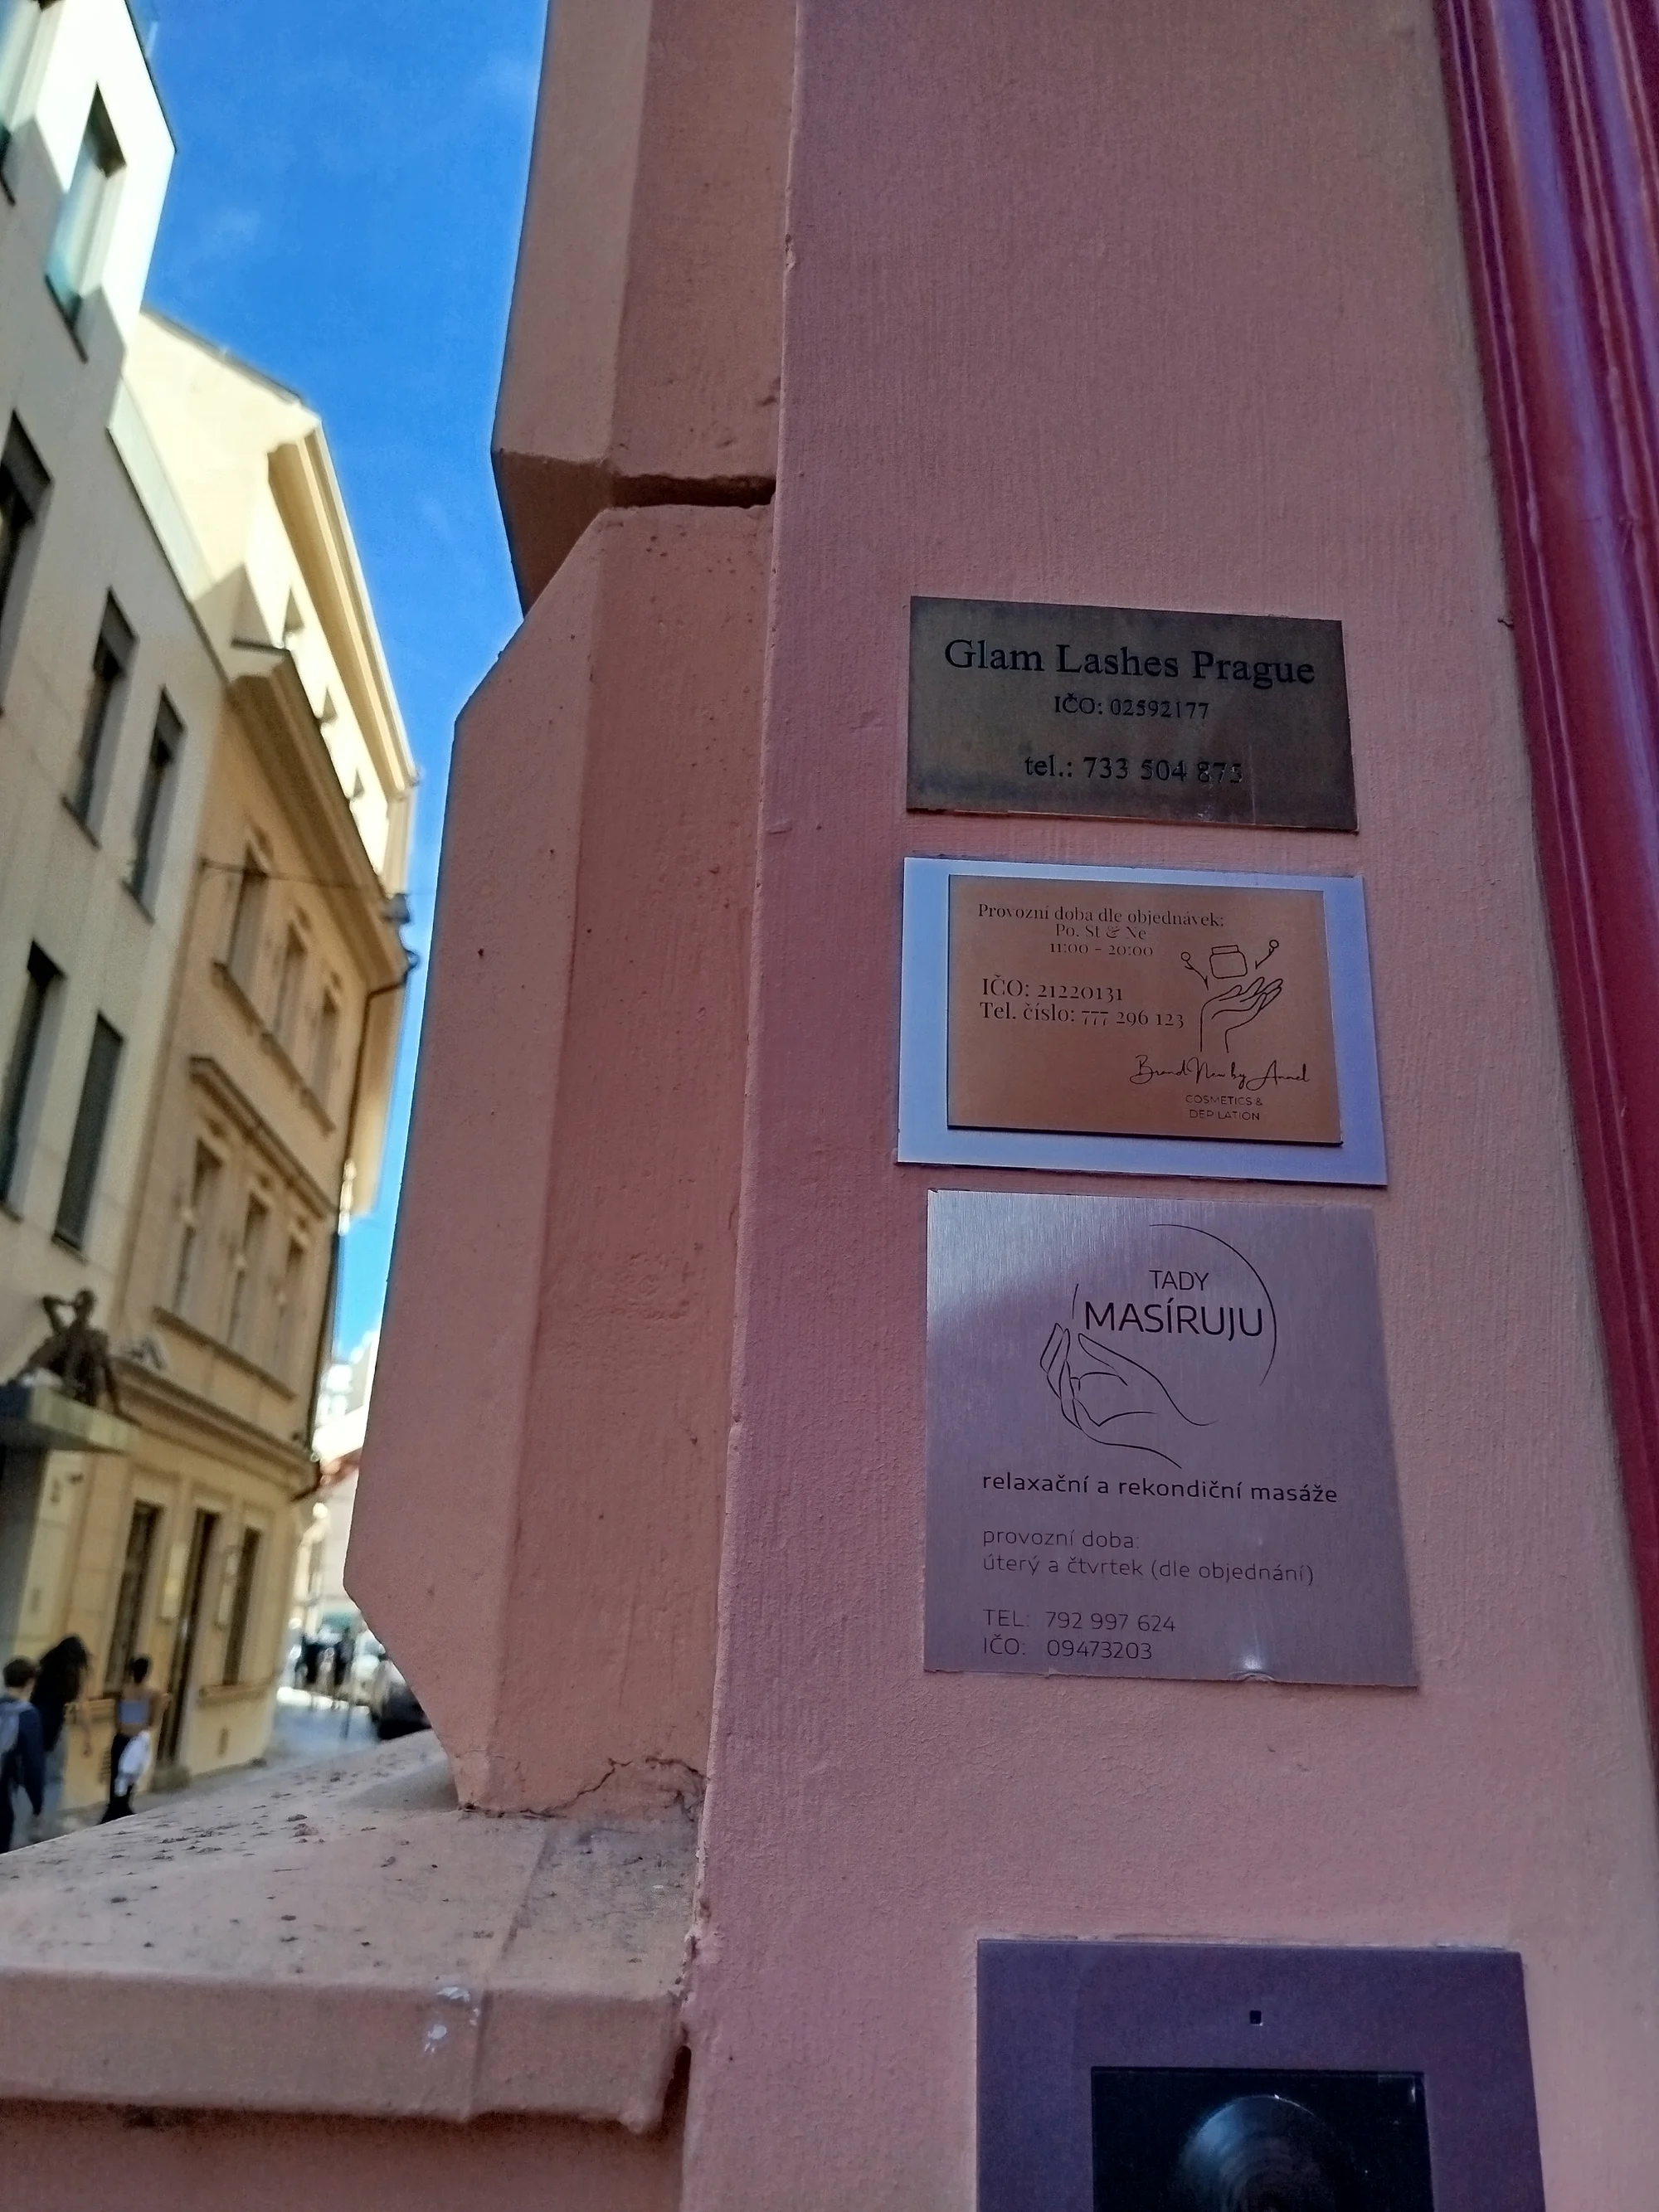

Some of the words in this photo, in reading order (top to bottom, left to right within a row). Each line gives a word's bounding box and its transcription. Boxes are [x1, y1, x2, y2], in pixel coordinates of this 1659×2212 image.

[944, 637, 1045, 673] Glam
[1056, 644, 1180, 679] Lashes
[1191, 649, 1316, 690] Prague
[1053, 690, 1104, 717] IČO:
[1109, 695, 1211, 722] 02592177
[1024, 753, 1073, 778] tel.:
[1082, 755, 1129, 781] 733
[1140, 758, 1189, 783] 504
[977, 901, 1051, 921] Provozní
[1053, 906, 1094, 924] doba
[1097, 909, 1123, 925] dle
[1126, 910, 1225, 929] objednávek:
[1083, 926, 1101, 941] St
[1126, 926, 1147, 941] Ne
[1048, 941, 1089, 955] 11:00
[1107, 945, 1154, 957] 20:00
[980, 972, 1031, 999] IČO:
[1037, 983, 1124, 1004] 21220131
[979, 999, 1018, 1022] Tel.
[1022, 1000, 1076, 1025] číslo:
[1080, 1009, 1110, 1027] 777
[1116, 1009, 1150, 1028] 296
[1155, 1011, 1185, 1030] 123
[1185, 1093, 1253, 1108] COSMETICS
[1189, 1108, 1261, 1123] DEPILATION
[1150, 1269, 1209, 1292] TADY
[1085, 1297, 1264, 1342] MASÍRUJU
[982, 1471, 1088, 1495] relaxační
[1097, 1480, 1110, 1496] a
[1118, 1476, 1242, 1501] rekondiční
[1251, 1483, 1339, 1505] masáže
[982, 1529, 1075, 1548] provozní
[1082, 1531, 1140, 1551] doba:
[982, 1553, 1040, 1579] úterý
[1048, 1561, 1059, 1574] a
[1068, 1556, 1145, 1579] čtvrtek
[1151, 1559, 1190, 1582] (dle
[1198, 1562, 1314, 1586] objednání)
[982, 1609, 1030, 1629] TEL:
[1045, 1611, 1083, 1631] 792
[1090, 1612, 1129, 1632] 997
[1137, 1614, 1176, 1633] 624
[983, 1632, 1027, 1657] IČO:
[1046, 1639, 1153, 1661] 09473203
